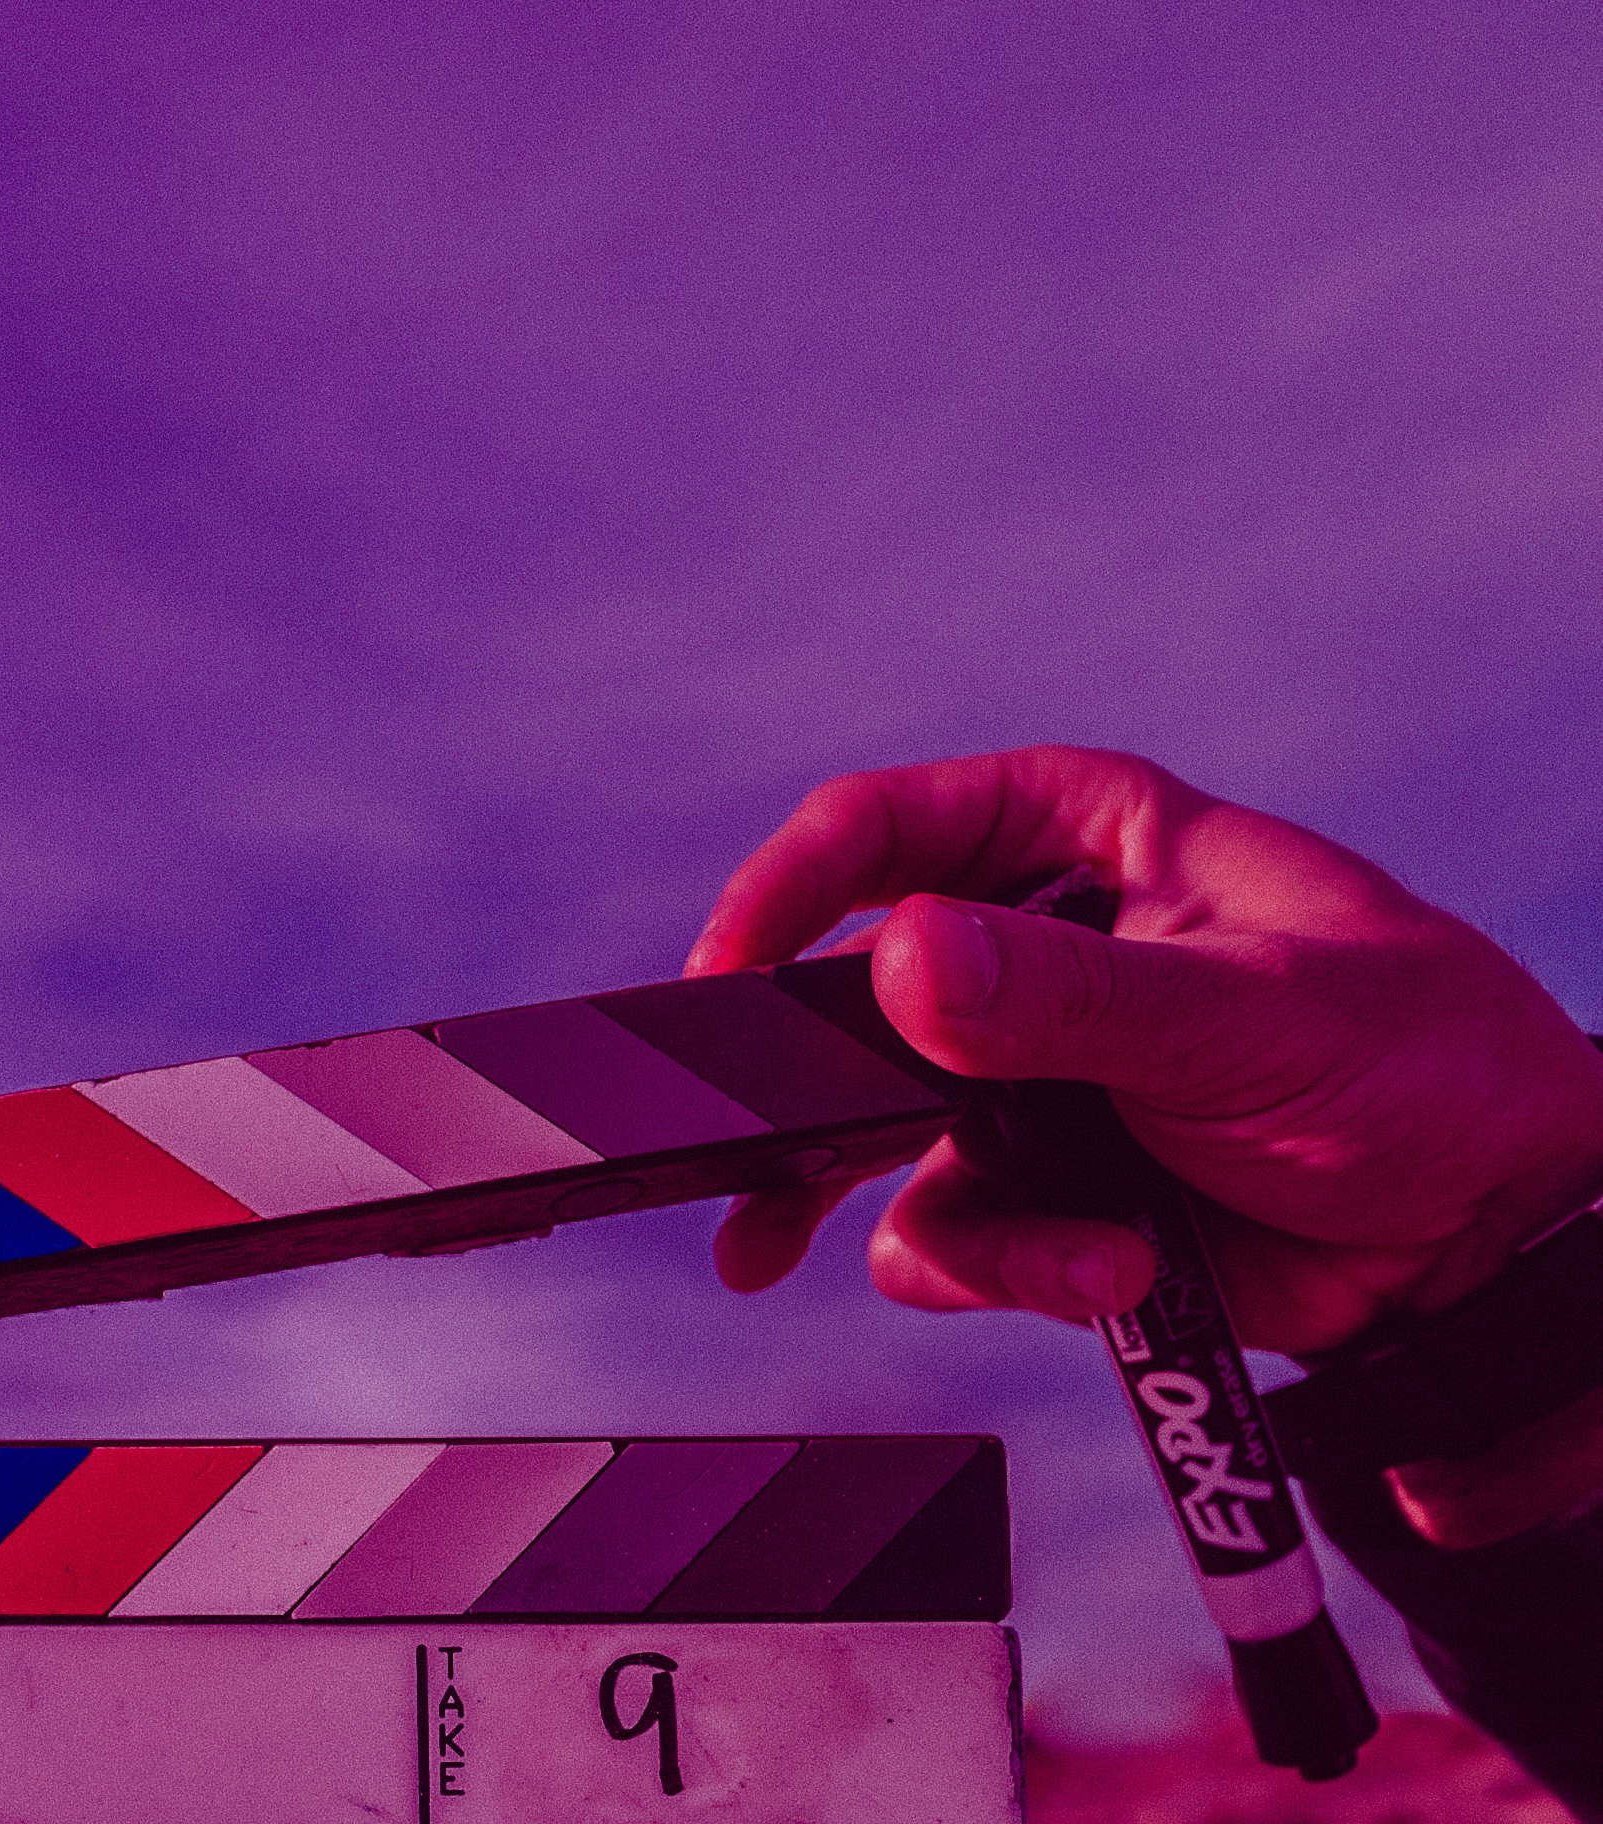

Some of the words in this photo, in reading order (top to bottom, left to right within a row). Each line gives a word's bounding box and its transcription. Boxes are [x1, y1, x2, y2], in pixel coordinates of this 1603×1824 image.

[1212, 1346, 1251, 1420] erase
[1241, 1420, 1268, 1469] dry
[1135, 1371, 1274, 1552] EXPO
[438, 1646, 465, 1797] TAKE
[598, 1652, 684, 1796] 9
